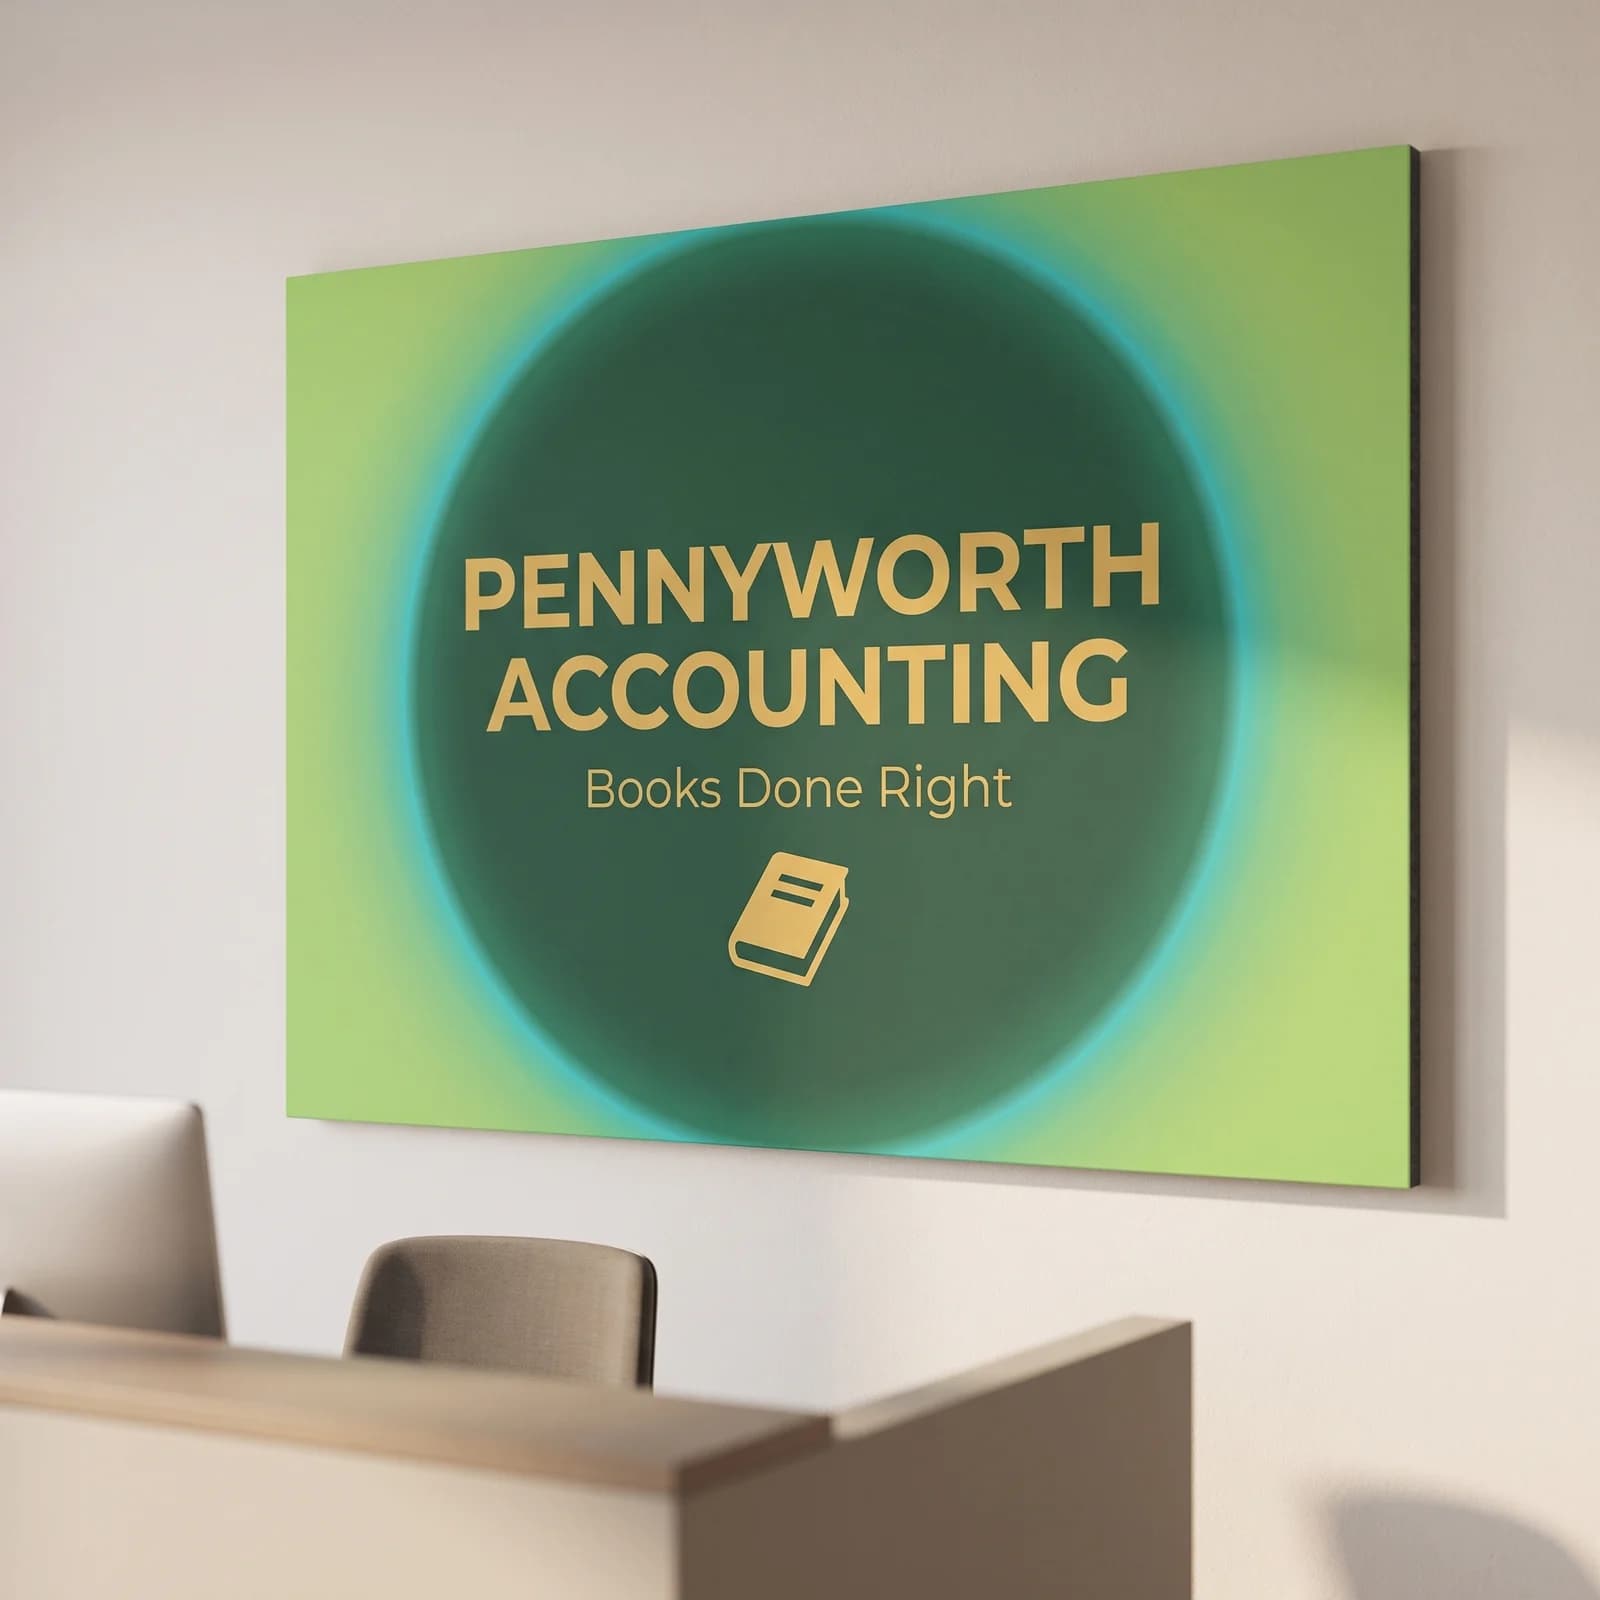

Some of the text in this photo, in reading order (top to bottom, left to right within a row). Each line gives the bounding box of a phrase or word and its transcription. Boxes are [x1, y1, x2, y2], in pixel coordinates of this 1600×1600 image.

[465, 522, 1160, 631] PENNYWORTH
[486, 637, 1128, 732] ACCOUNTING
[585, 763, 1012, 819] Books Done Right
